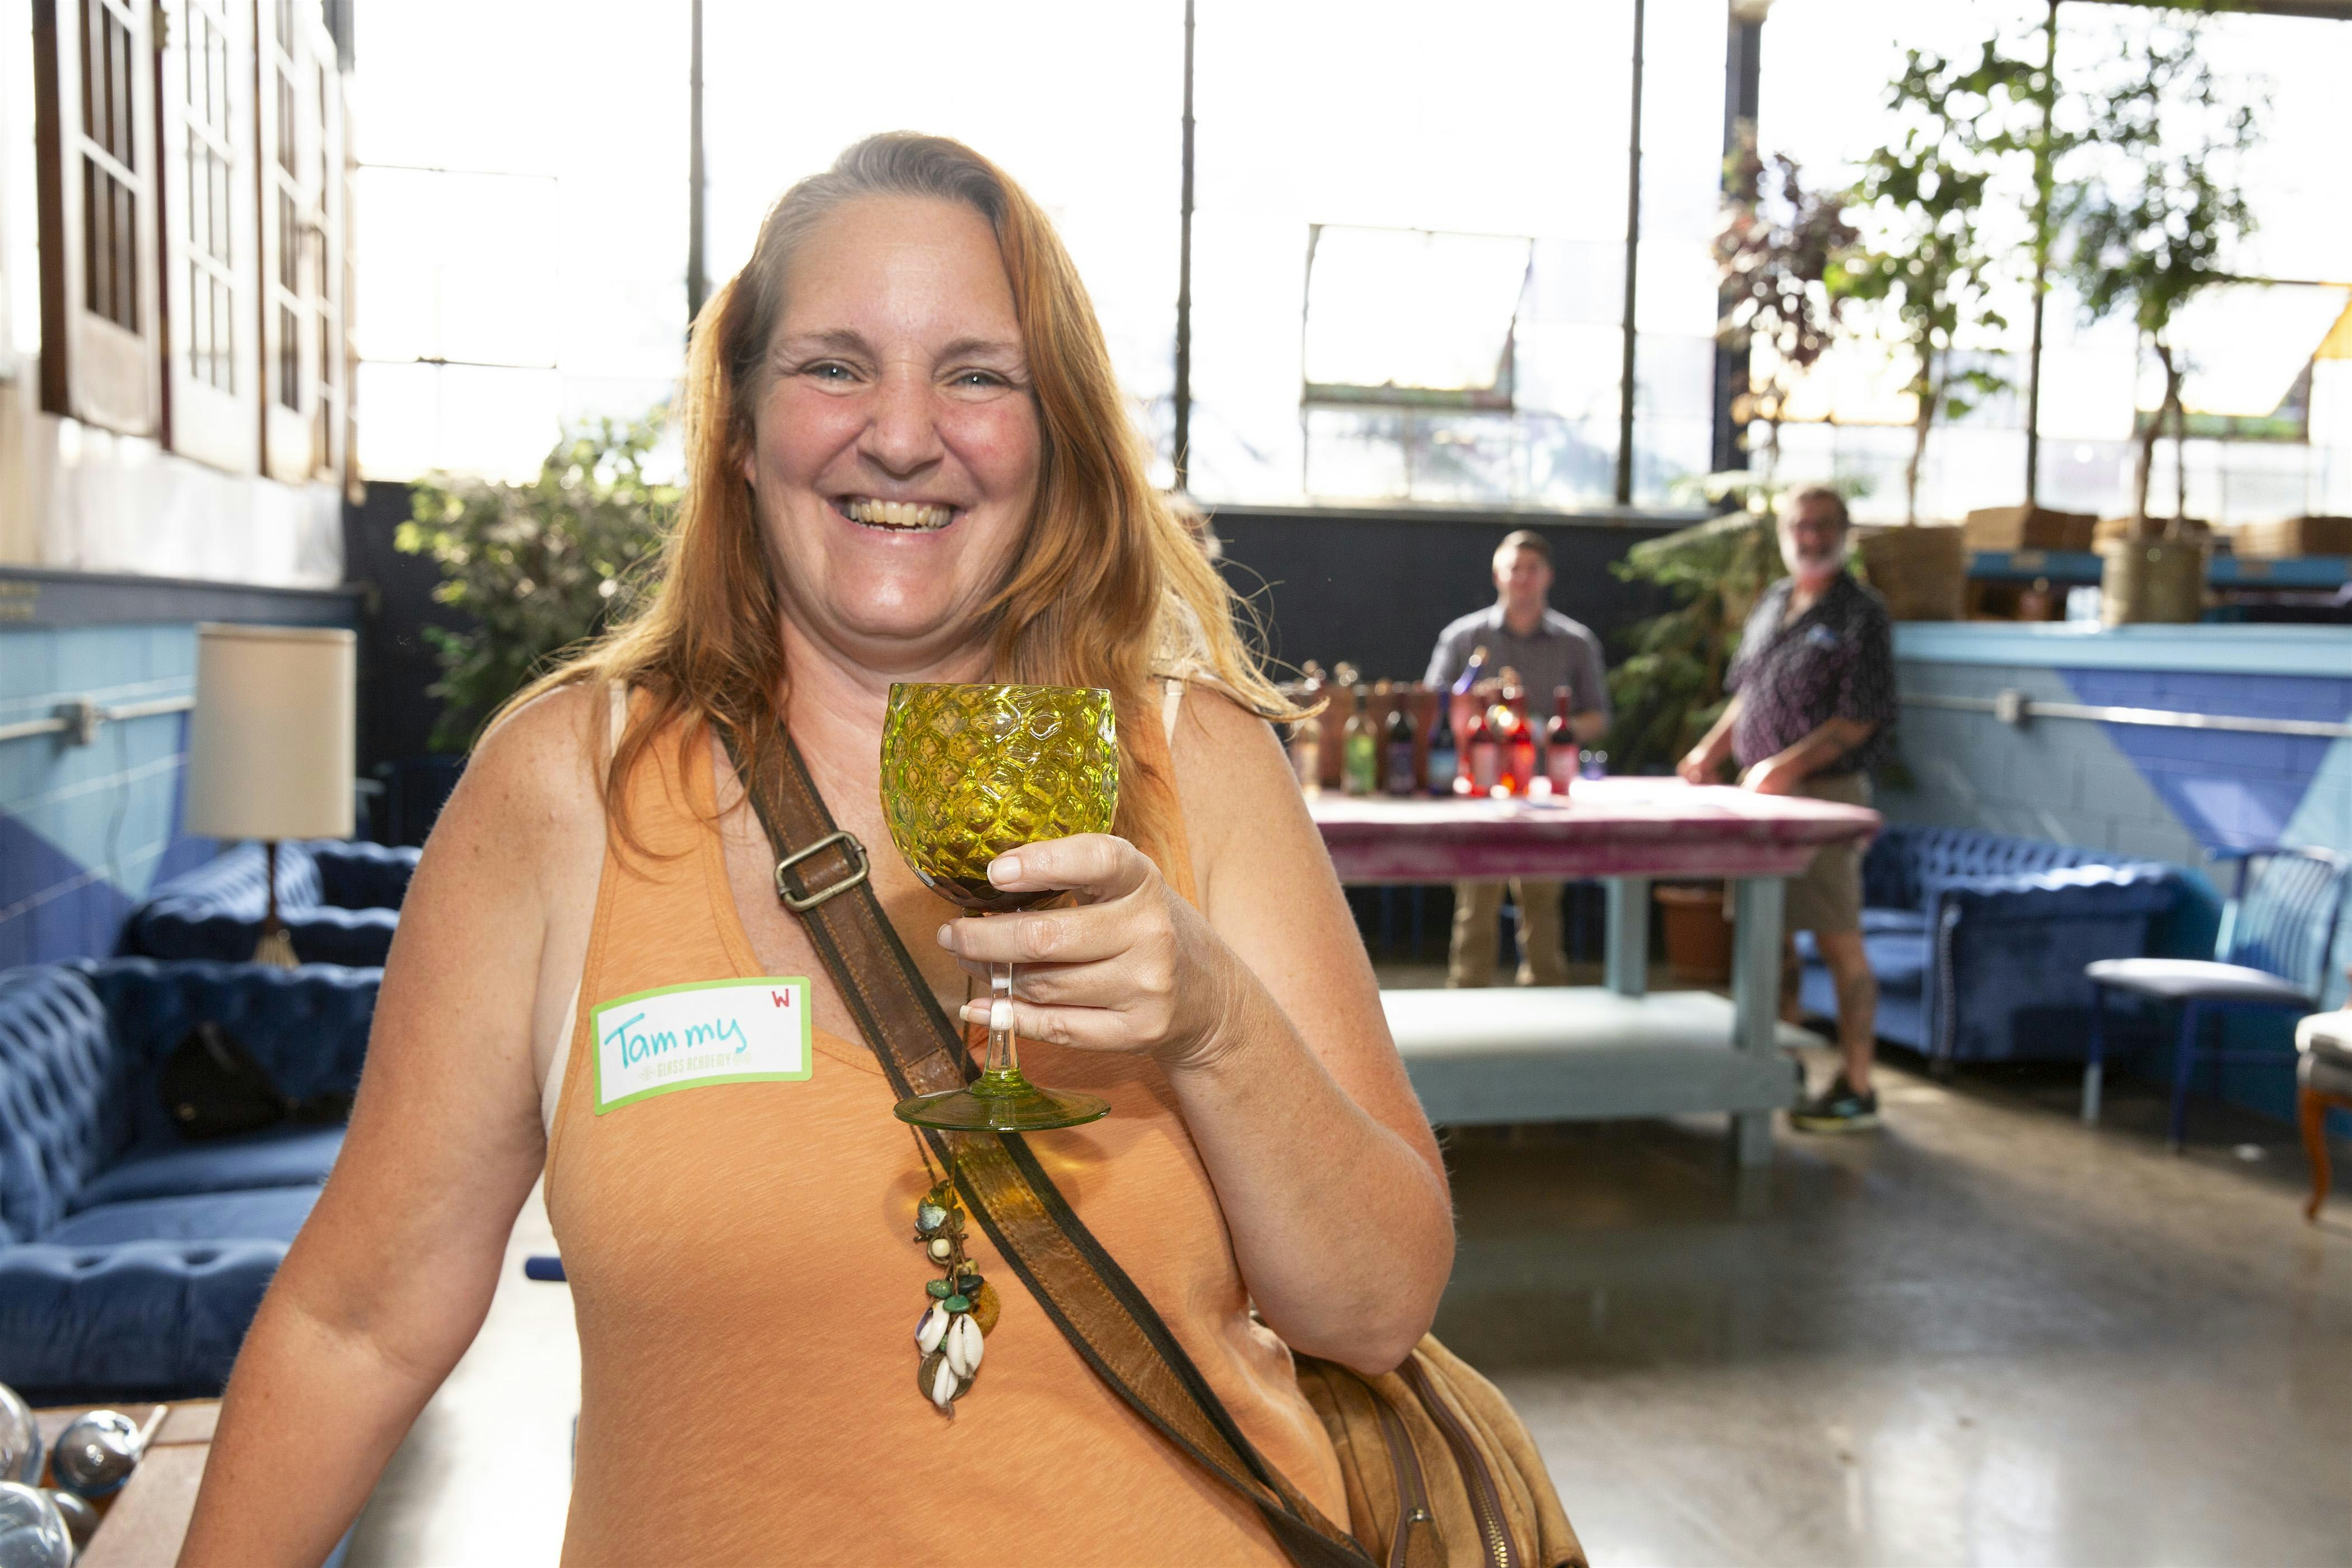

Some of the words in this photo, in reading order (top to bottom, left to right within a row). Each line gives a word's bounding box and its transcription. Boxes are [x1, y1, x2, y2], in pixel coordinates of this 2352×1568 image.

[772, 988, 790, 1007] W
[604, 1012, 747, 1069] Tammy
[657, 1059, 684, 1077] GLASS
[687, 1053, 731, 1071] ACADEMY
